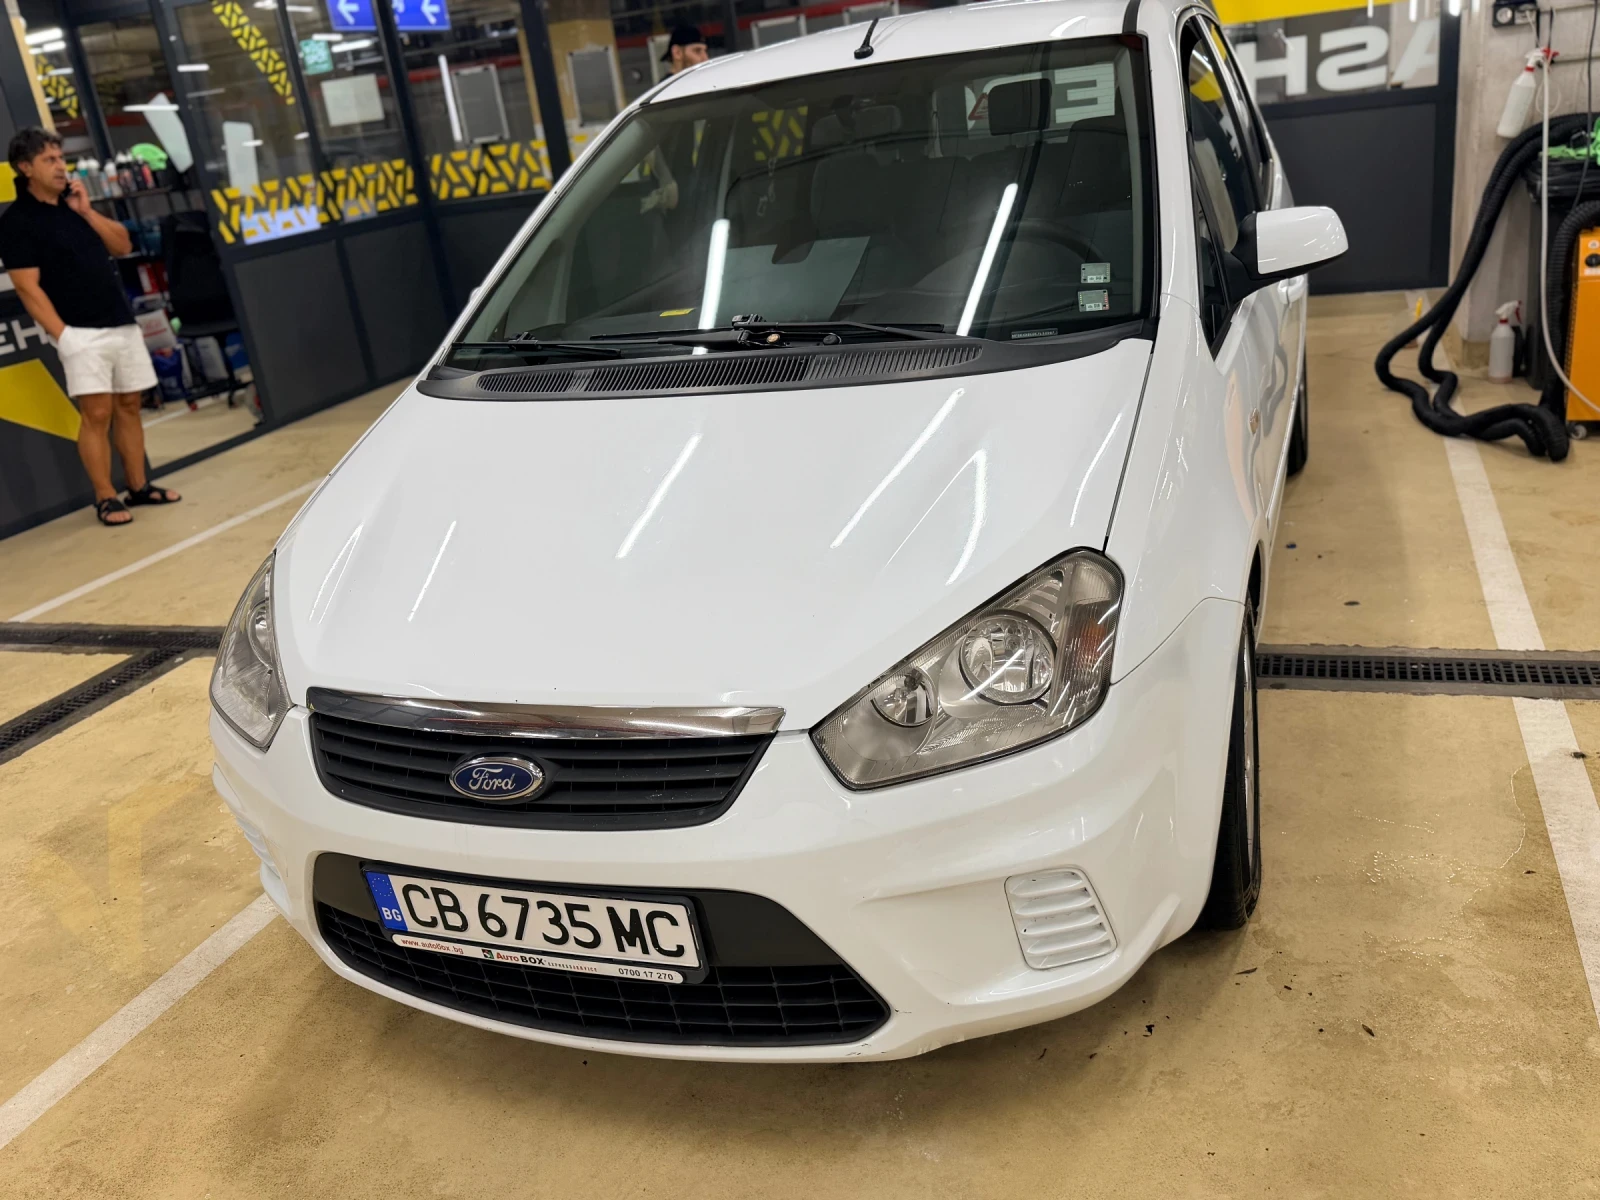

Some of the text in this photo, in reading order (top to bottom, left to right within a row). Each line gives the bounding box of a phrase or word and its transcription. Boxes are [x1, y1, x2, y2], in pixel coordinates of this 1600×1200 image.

[468, 767, 516, 791] Ford
[381, 907, 403, 921] BG
[402, 884, 685, 958] CB 6735 MC
[618, 968, 641, 977] 0700
[656, 972, 674, 981] 270
